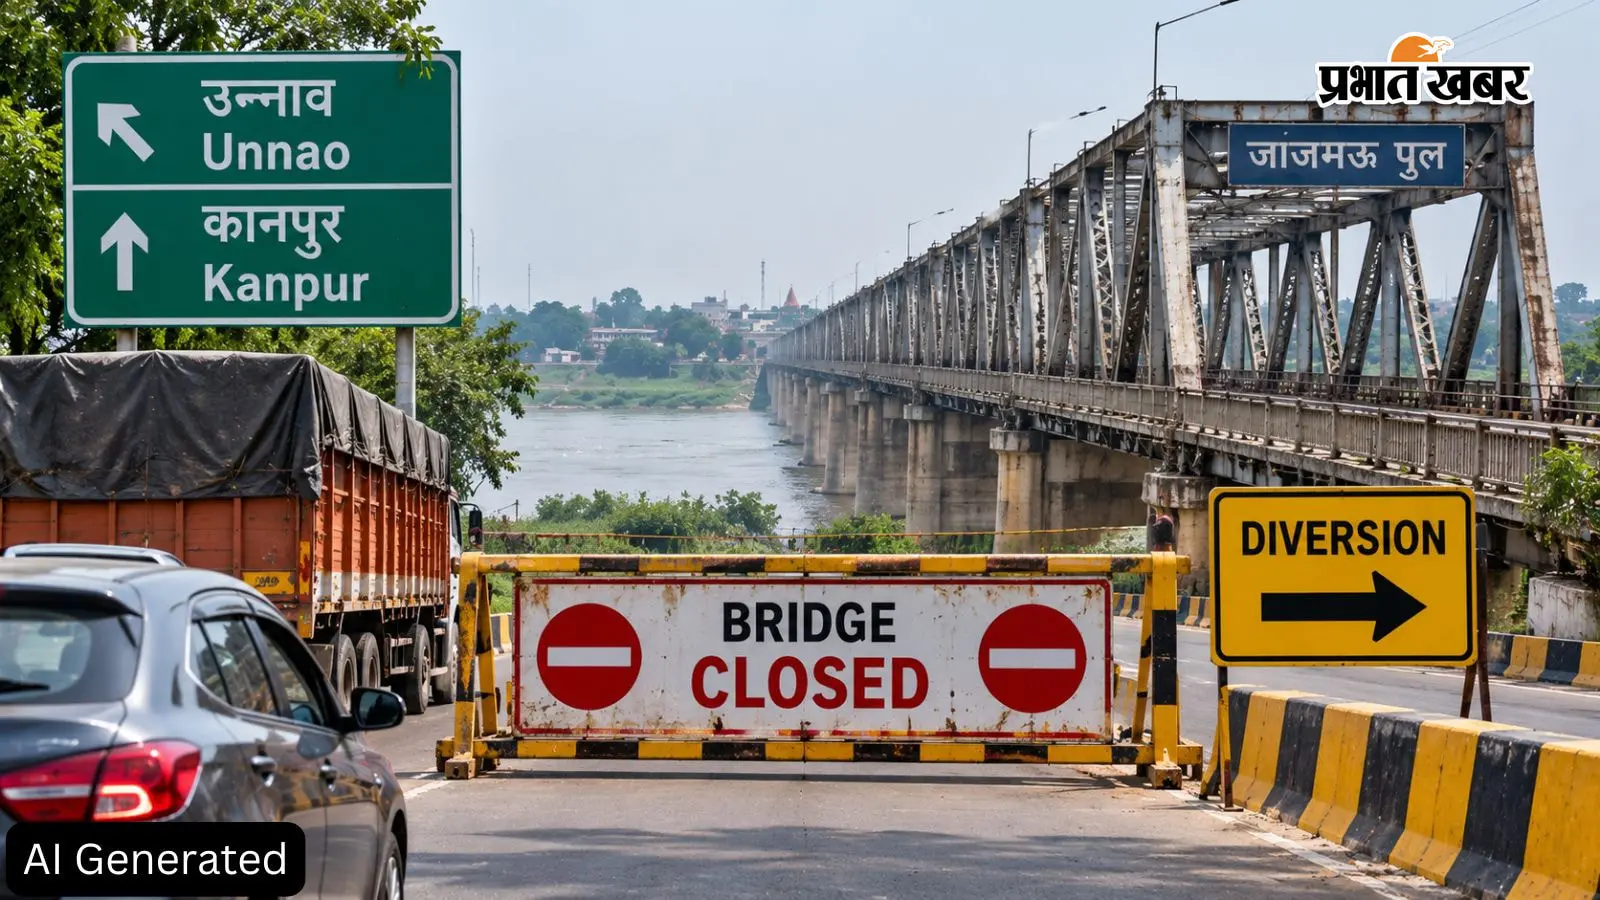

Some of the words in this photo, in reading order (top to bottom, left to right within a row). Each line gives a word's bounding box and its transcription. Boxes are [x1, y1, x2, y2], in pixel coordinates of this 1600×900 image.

[201, 80, 337, 117] उन्नाव
[204, 133, 350, 171] Unnao
[1393, 142, 1448, 181] पुल
[202, 206, 345, 259] कानपुर
[205, 264, 369, 312] Kanpur
[1241, 520, 1446, 556] DIVERSION
[723, 602, 895, 644] BRIDGE
[691, 656, 929, 709] CLOSED
